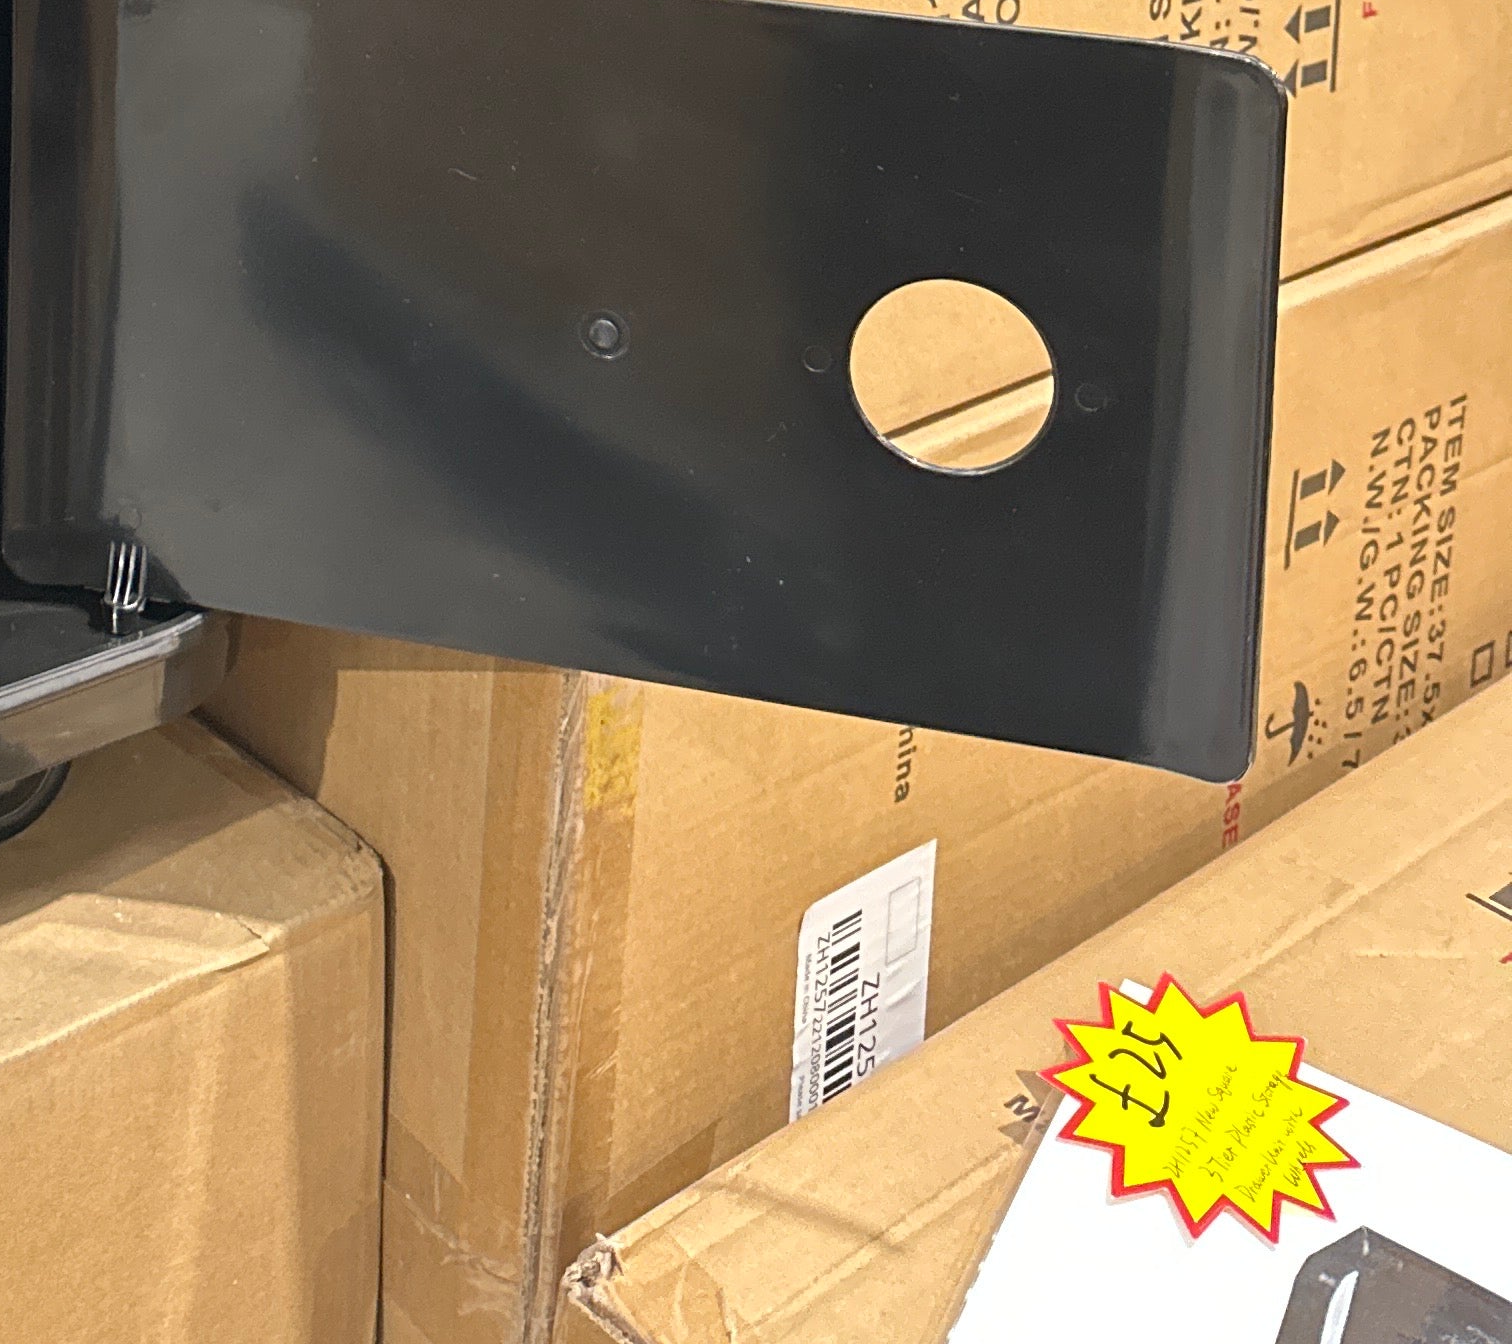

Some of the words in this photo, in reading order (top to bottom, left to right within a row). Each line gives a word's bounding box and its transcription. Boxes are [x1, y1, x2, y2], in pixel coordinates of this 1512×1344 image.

[1388, 416, 1417, 520] CTN:
[1440, 393, 1468, 496] ITEM
[1385, 531, 1404, 551] 1
[1405, 404, 1441, 601] PACKING
[1089, 1020, 1183, 1128] £25
